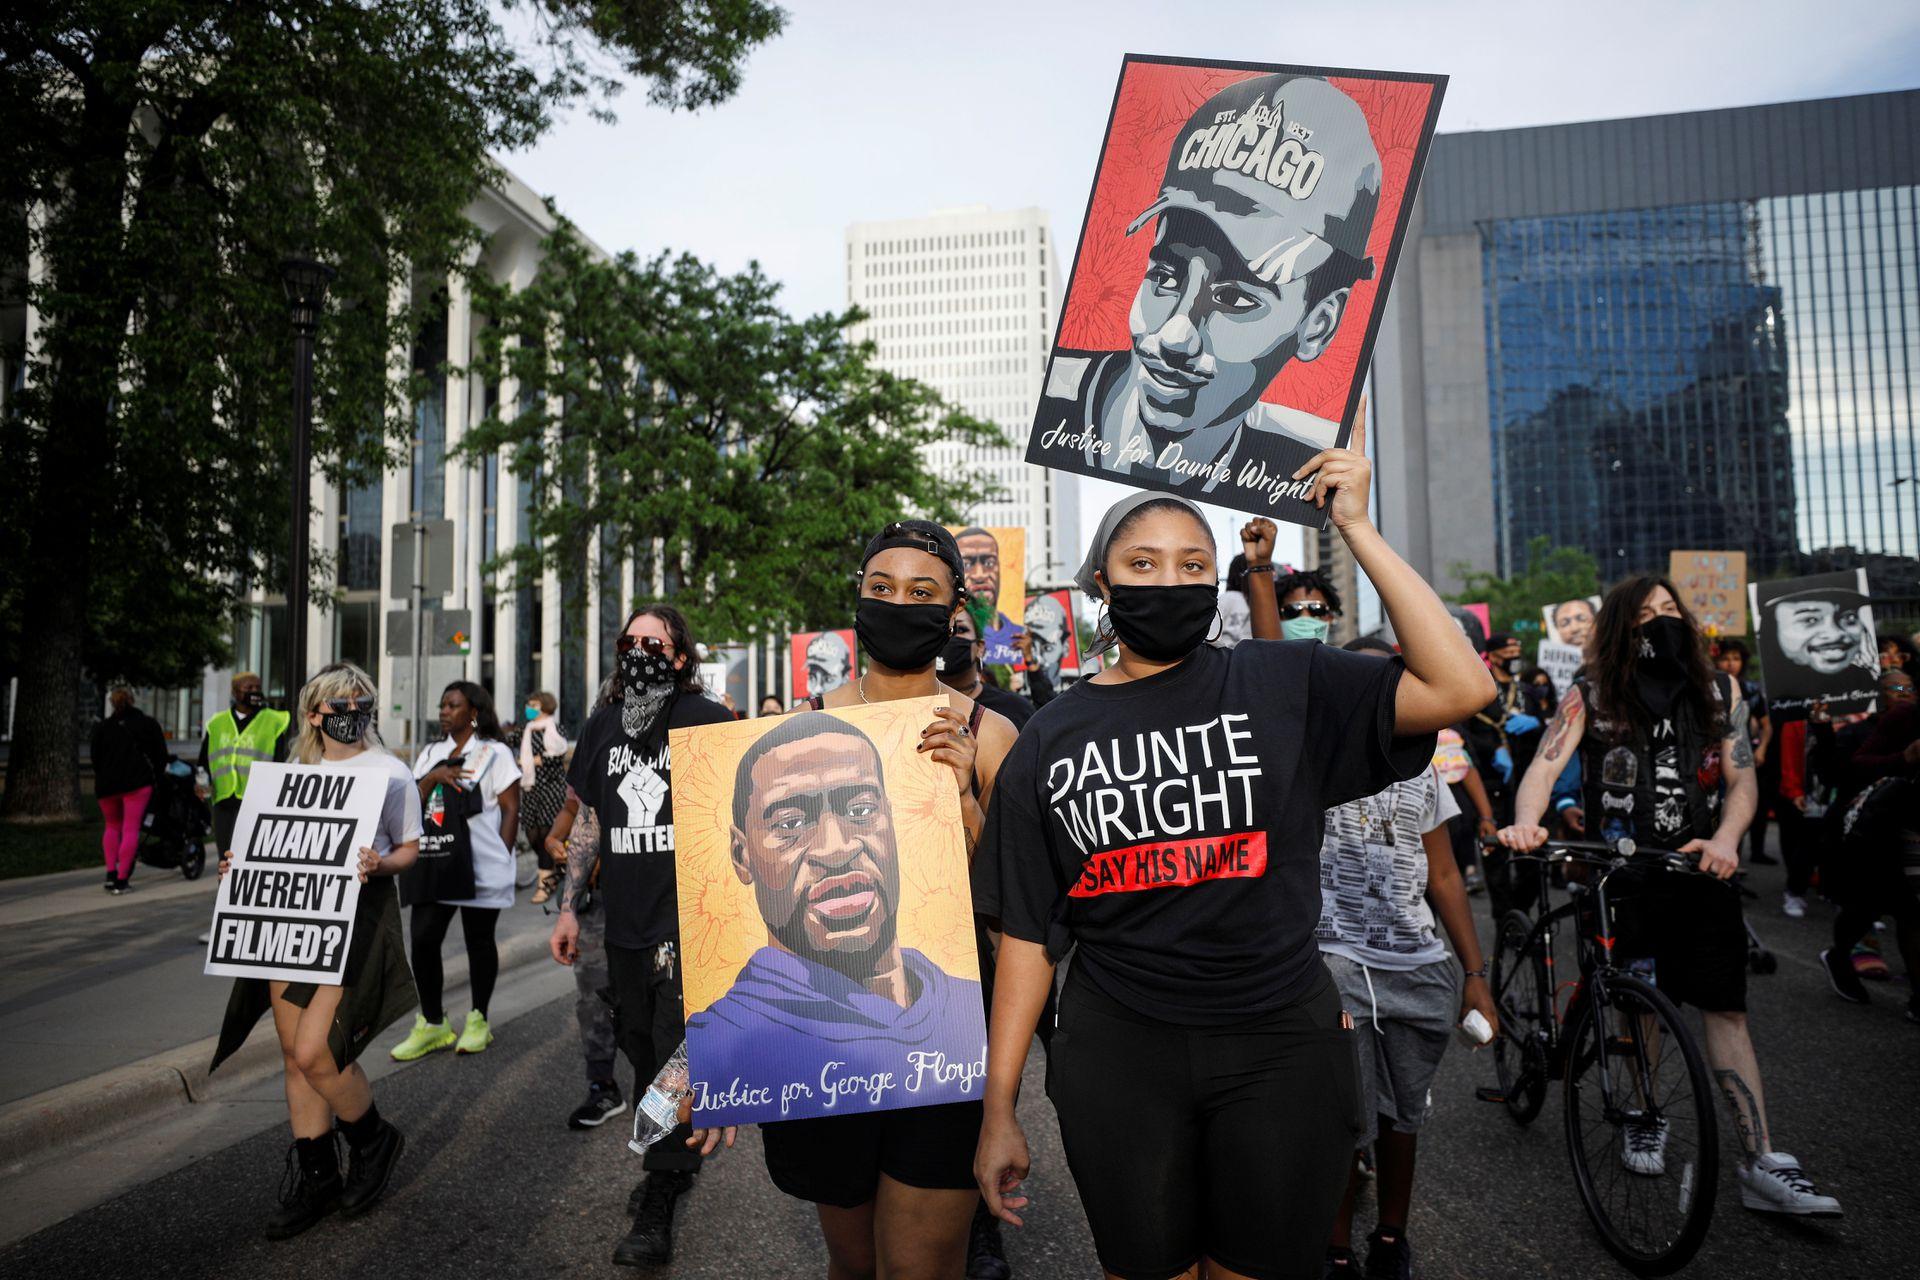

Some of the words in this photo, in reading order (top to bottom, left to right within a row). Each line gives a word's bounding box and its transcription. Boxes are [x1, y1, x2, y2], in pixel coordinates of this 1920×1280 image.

[1178, 122, 1325, 200] CHICAGO
[1041, 419, 1111, 456] Justice
[1113, 435, 1151, 468] for
[1156, 442, 1230, 483] Daunte
[1237, 459, 1314, 504] Wright
[1047, 713, 1259, 804] DAUNTE
[276, 773, 355, 810] HOW
[1054, 767, 1262, 855] WRIGHT
[252, 819, 350, 861] MANY
[1135, 848, 1178, 885] HIS
[1185, 838, 1249, 880] NAME
[229, 868, 352, 912] WEREN'T
[216, 918, 342, 967] FILMED?
[692, 1076, 773, 1112] Justice
[780, 1081, 813, 1115] for
[820, 1061, 896, 1109] George
[905, 1045, 988, 1094] Floyd
